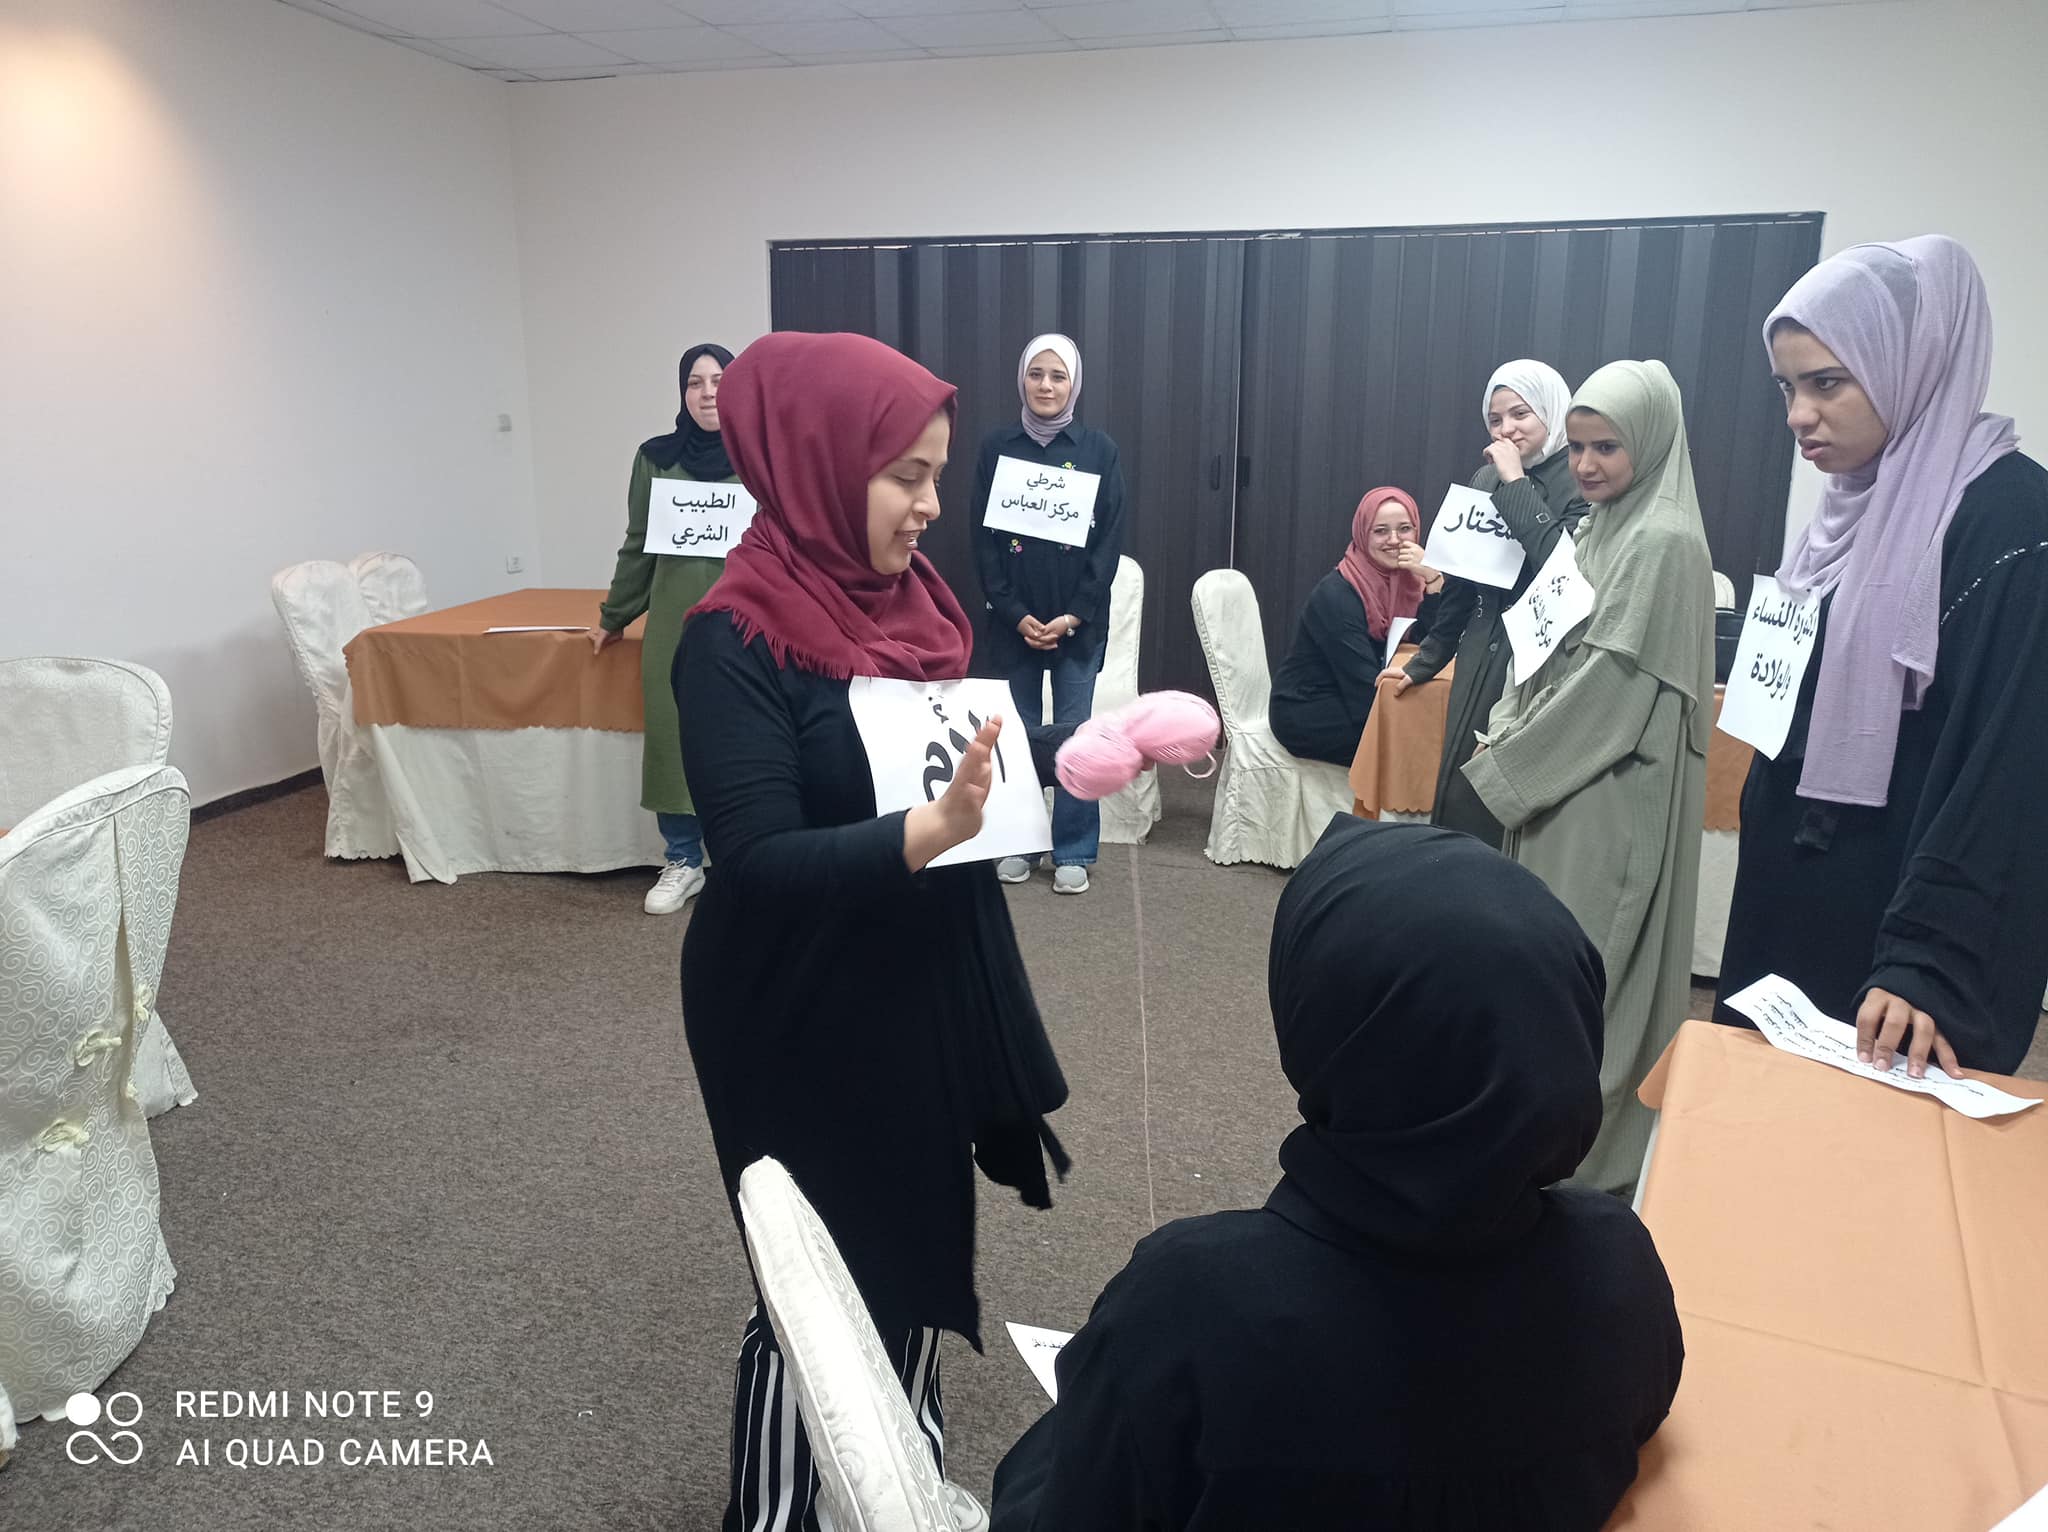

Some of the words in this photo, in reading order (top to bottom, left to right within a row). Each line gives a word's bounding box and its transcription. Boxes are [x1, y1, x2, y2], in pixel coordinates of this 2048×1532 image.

[1026, 473, 1066, 491] شرطي
[672, 492, 736, 513] الطبيب
[1001, 494, 1047, 512] العباس
[1047, 502, 1079, 522] مركز
[672, 524, 728, 549] الشرعي
[1752, 596, 1797, 630] النساء
